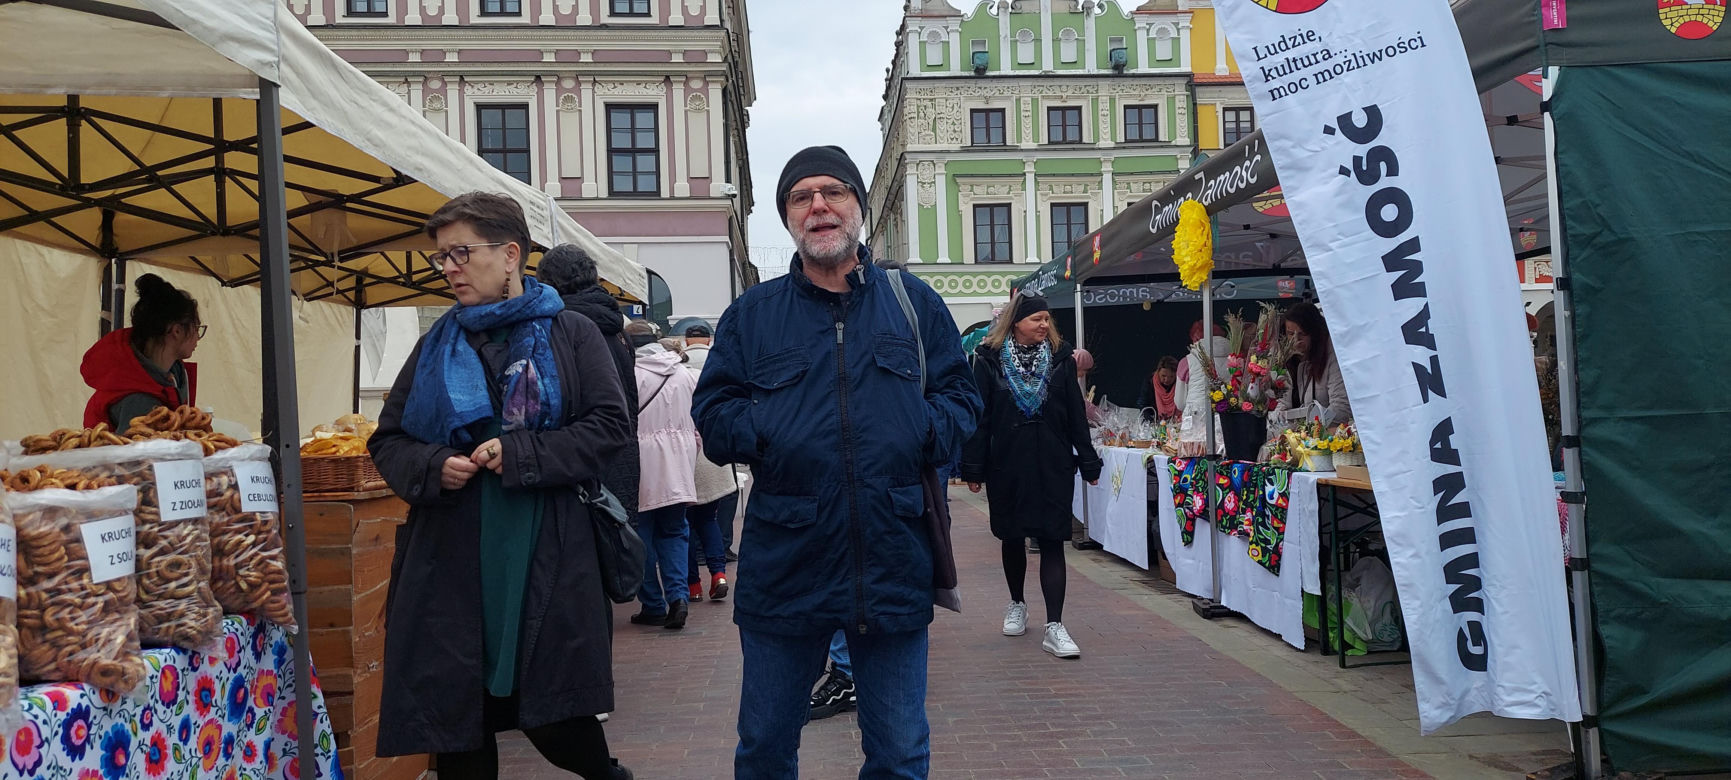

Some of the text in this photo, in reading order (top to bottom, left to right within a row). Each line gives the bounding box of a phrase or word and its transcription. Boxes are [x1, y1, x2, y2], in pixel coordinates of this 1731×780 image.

[1252, 28, 1322, 62] Ludzie,
[1268, 31, 1427, 102] moc możliwości
[1149, 139, 1262, 234] Gmin Zamość
[1323, 104, 1488, 673] GMINA ZAMOŚĆ
[171, 501, 178, 511] Z
[108, 554, 116, 566] Z
